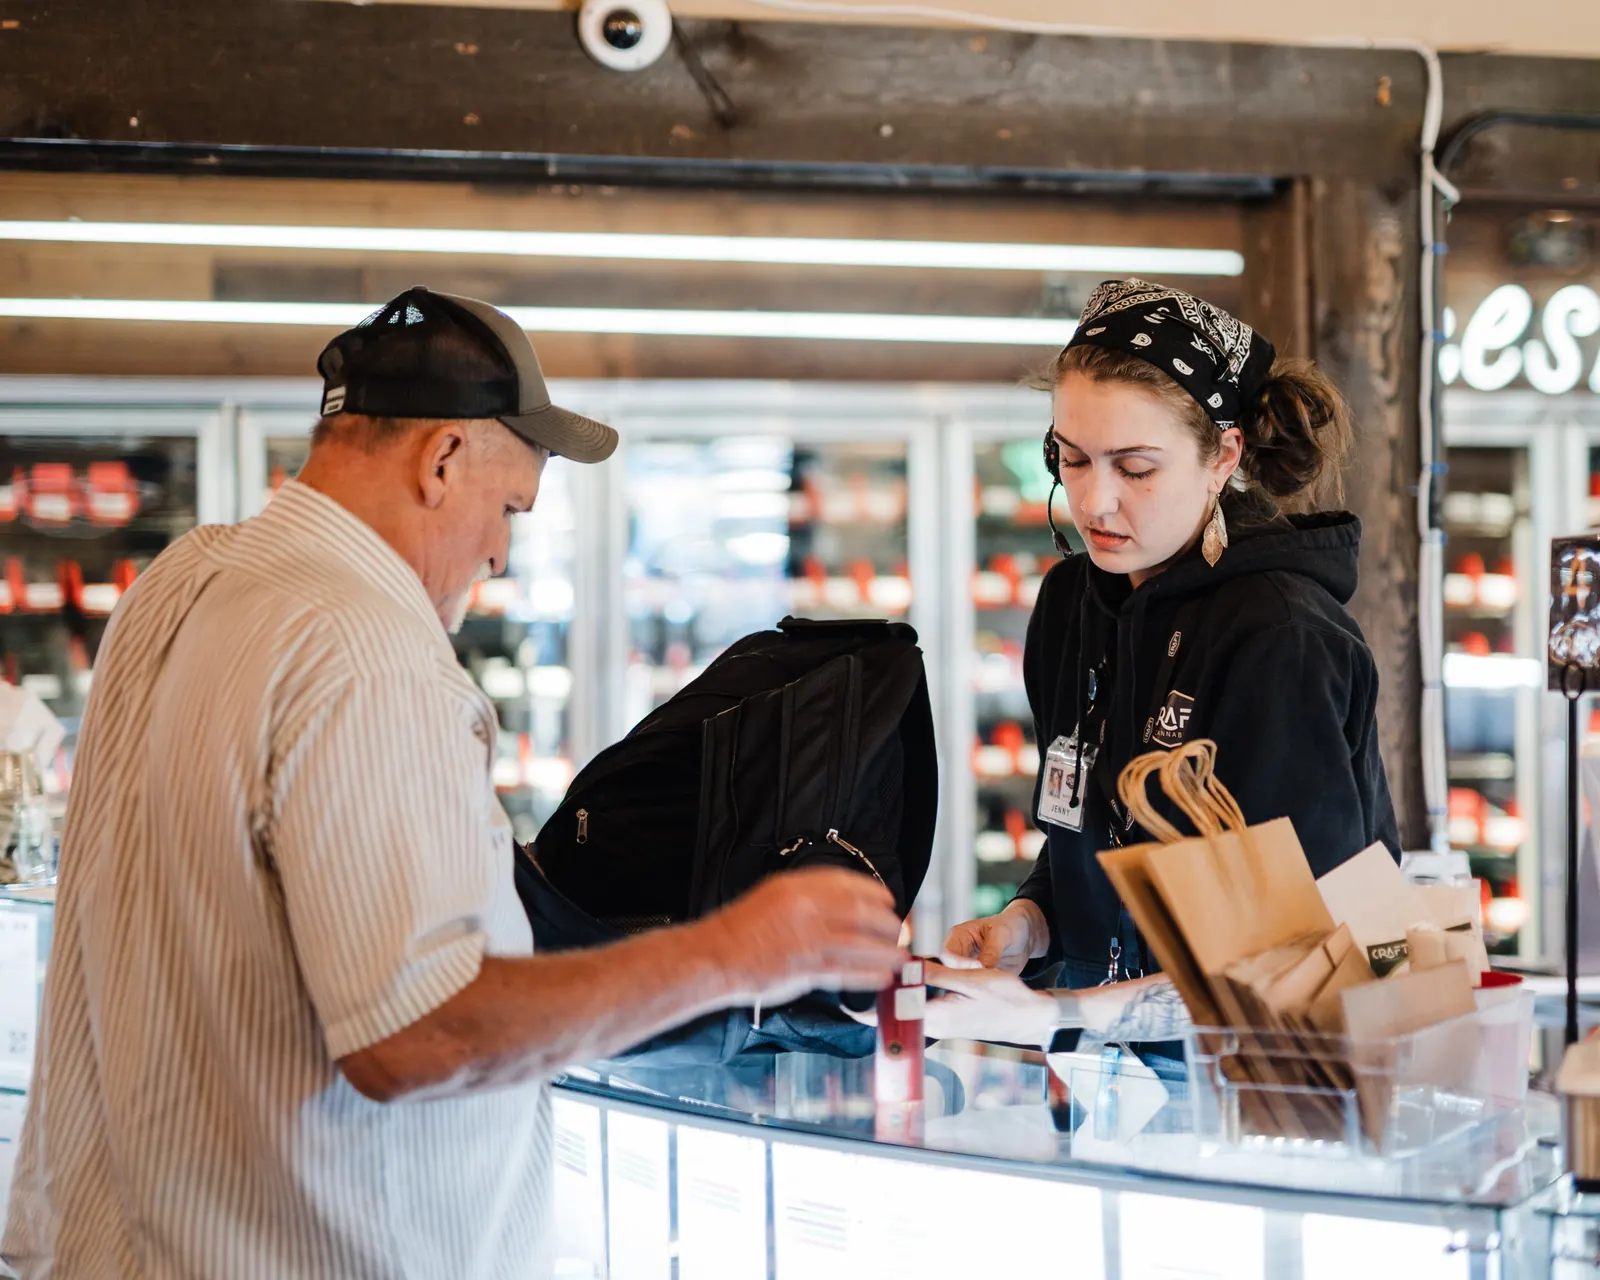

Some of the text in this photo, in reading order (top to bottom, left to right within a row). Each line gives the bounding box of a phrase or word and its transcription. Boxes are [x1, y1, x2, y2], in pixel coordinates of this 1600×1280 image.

[1438, 284, 1600, 395] es
[1155, 706, 1193, 731] RAF
[1154, 730, 1183, 738] ANNAB
[1051, 804, 1071, 817] JENNY
[1371, 944, 1408, 960] CRAFT
